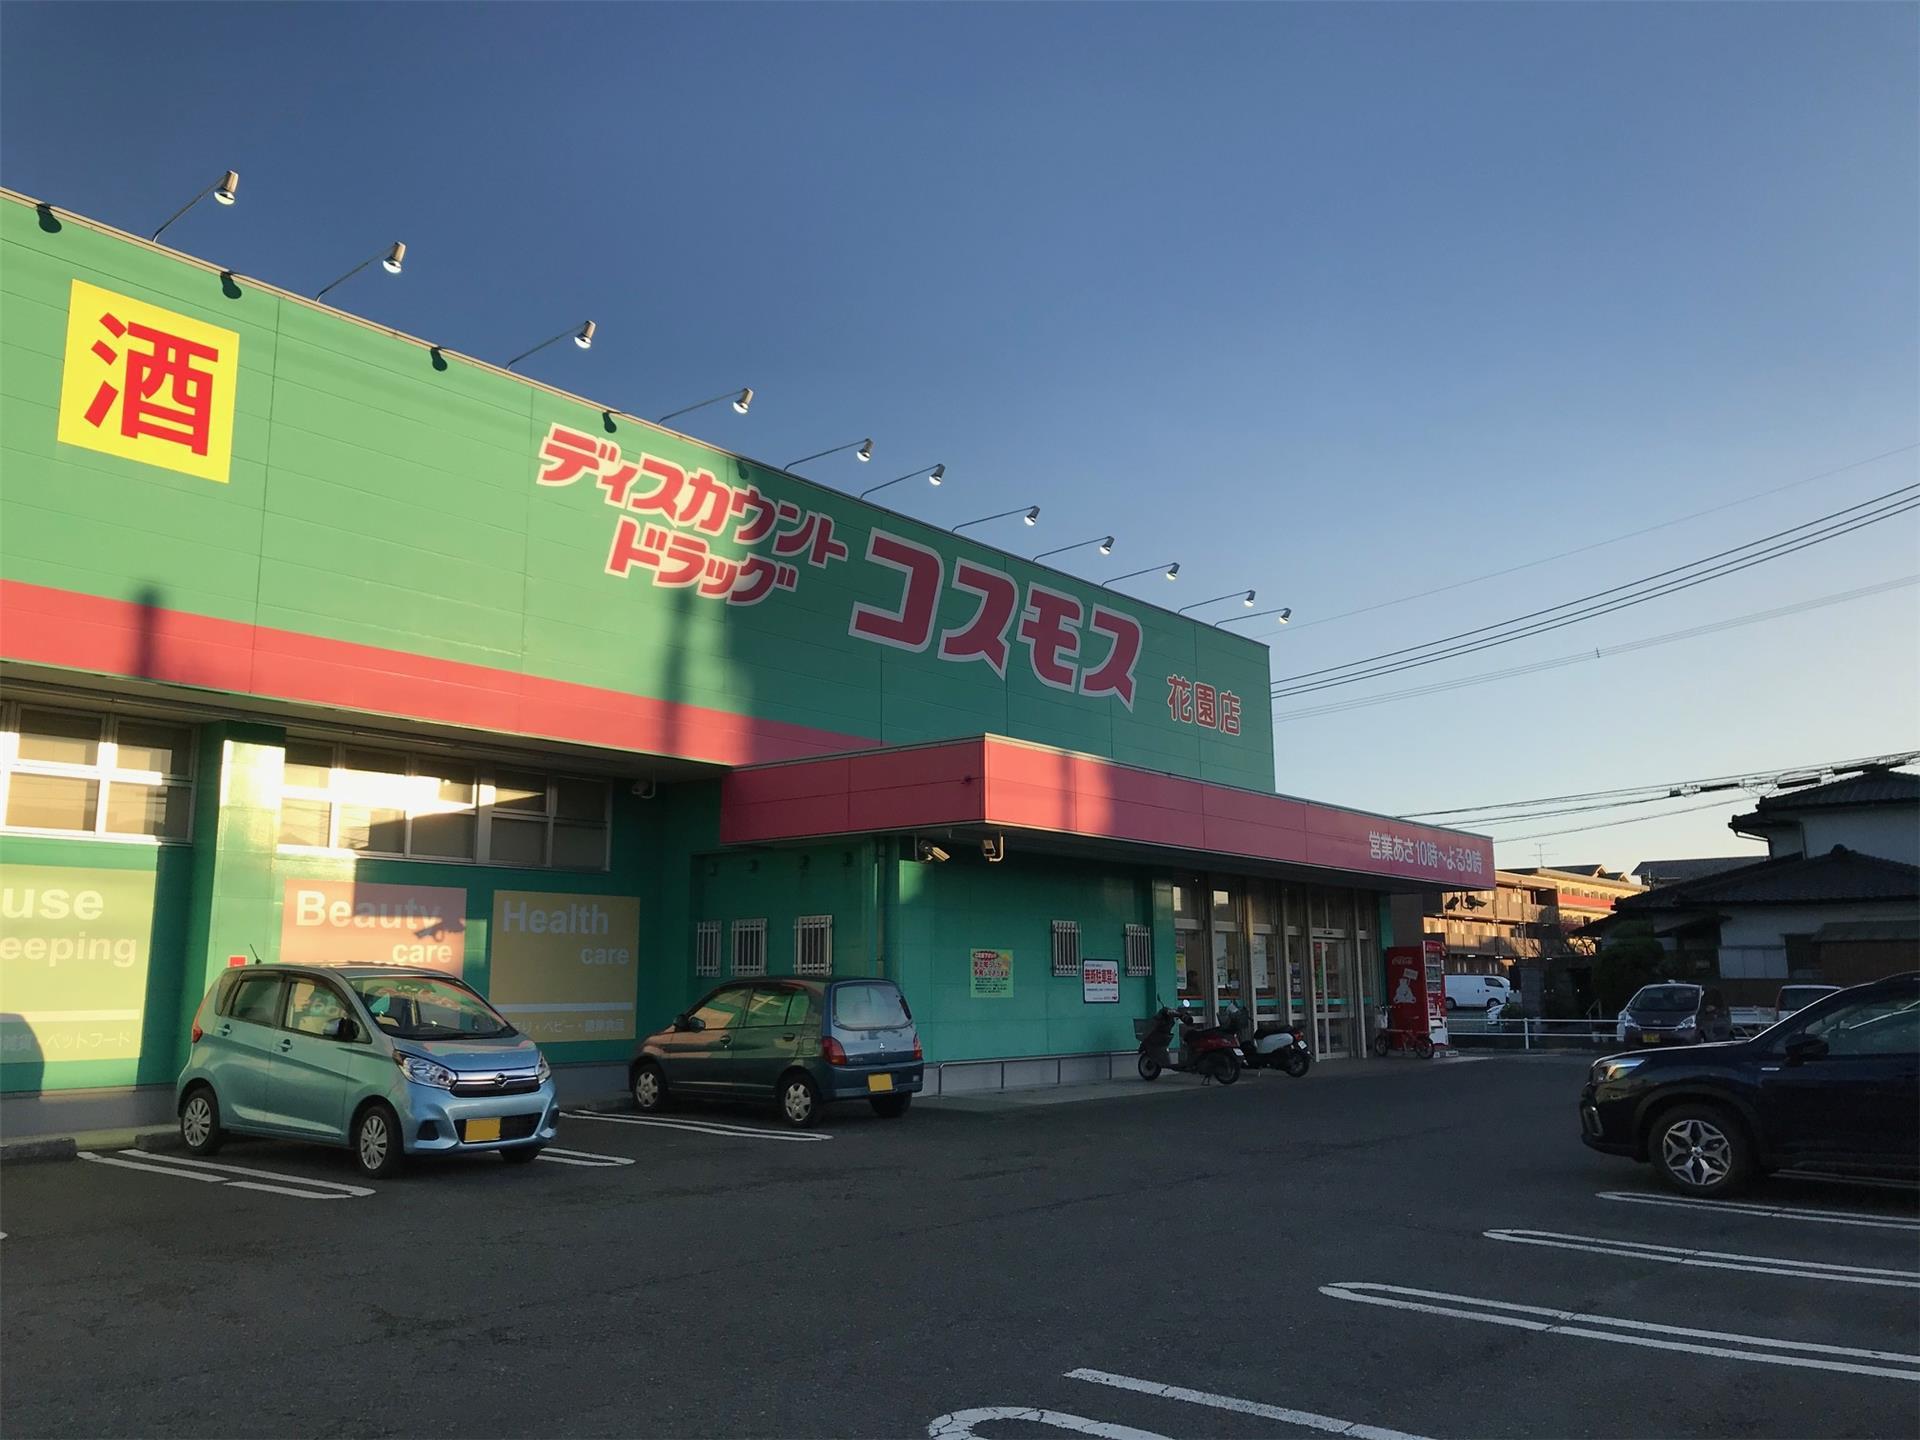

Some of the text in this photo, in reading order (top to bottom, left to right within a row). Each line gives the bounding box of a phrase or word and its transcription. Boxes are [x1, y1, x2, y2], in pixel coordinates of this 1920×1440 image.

[84, 312, 218, 456] 酒
[536, 422, 849, 569] ディスカウント
[604, 514, 799, 607] ドラッグ
[848, 527, 1143, 713] コスモス
[1166, 673, 1242, 736] 花園店
[296, 889, 442, 932] Beauty
[502, 900, 609, 935] Health
[391, 942, 453, 964] care
[580, 945, 630, 966] care
[45, 1031, 131, 1049] ペットフード
